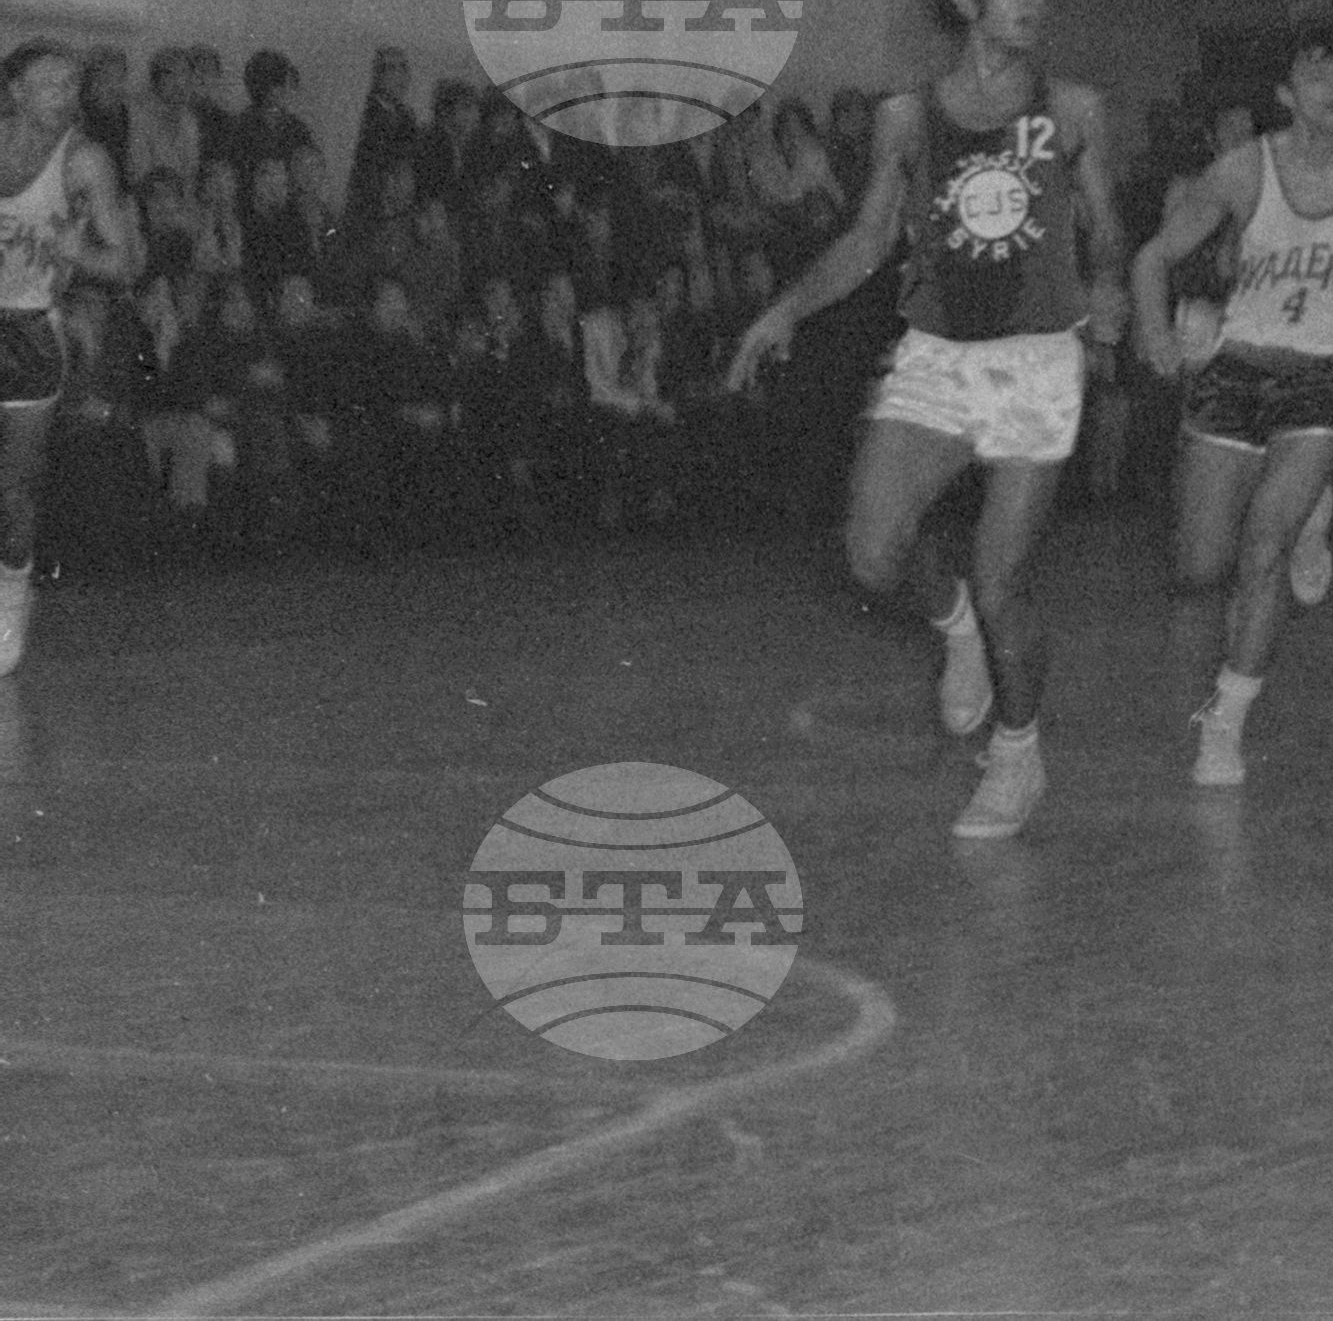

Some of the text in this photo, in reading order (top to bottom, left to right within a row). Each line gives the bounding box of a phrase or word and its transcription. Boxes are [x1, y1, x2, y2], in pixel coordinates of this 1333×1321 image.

[1016, 116, 1055, 159] 12
[947, 217, 1046, 261] SYRIE
[1282, 287, 1309, 323] 4
